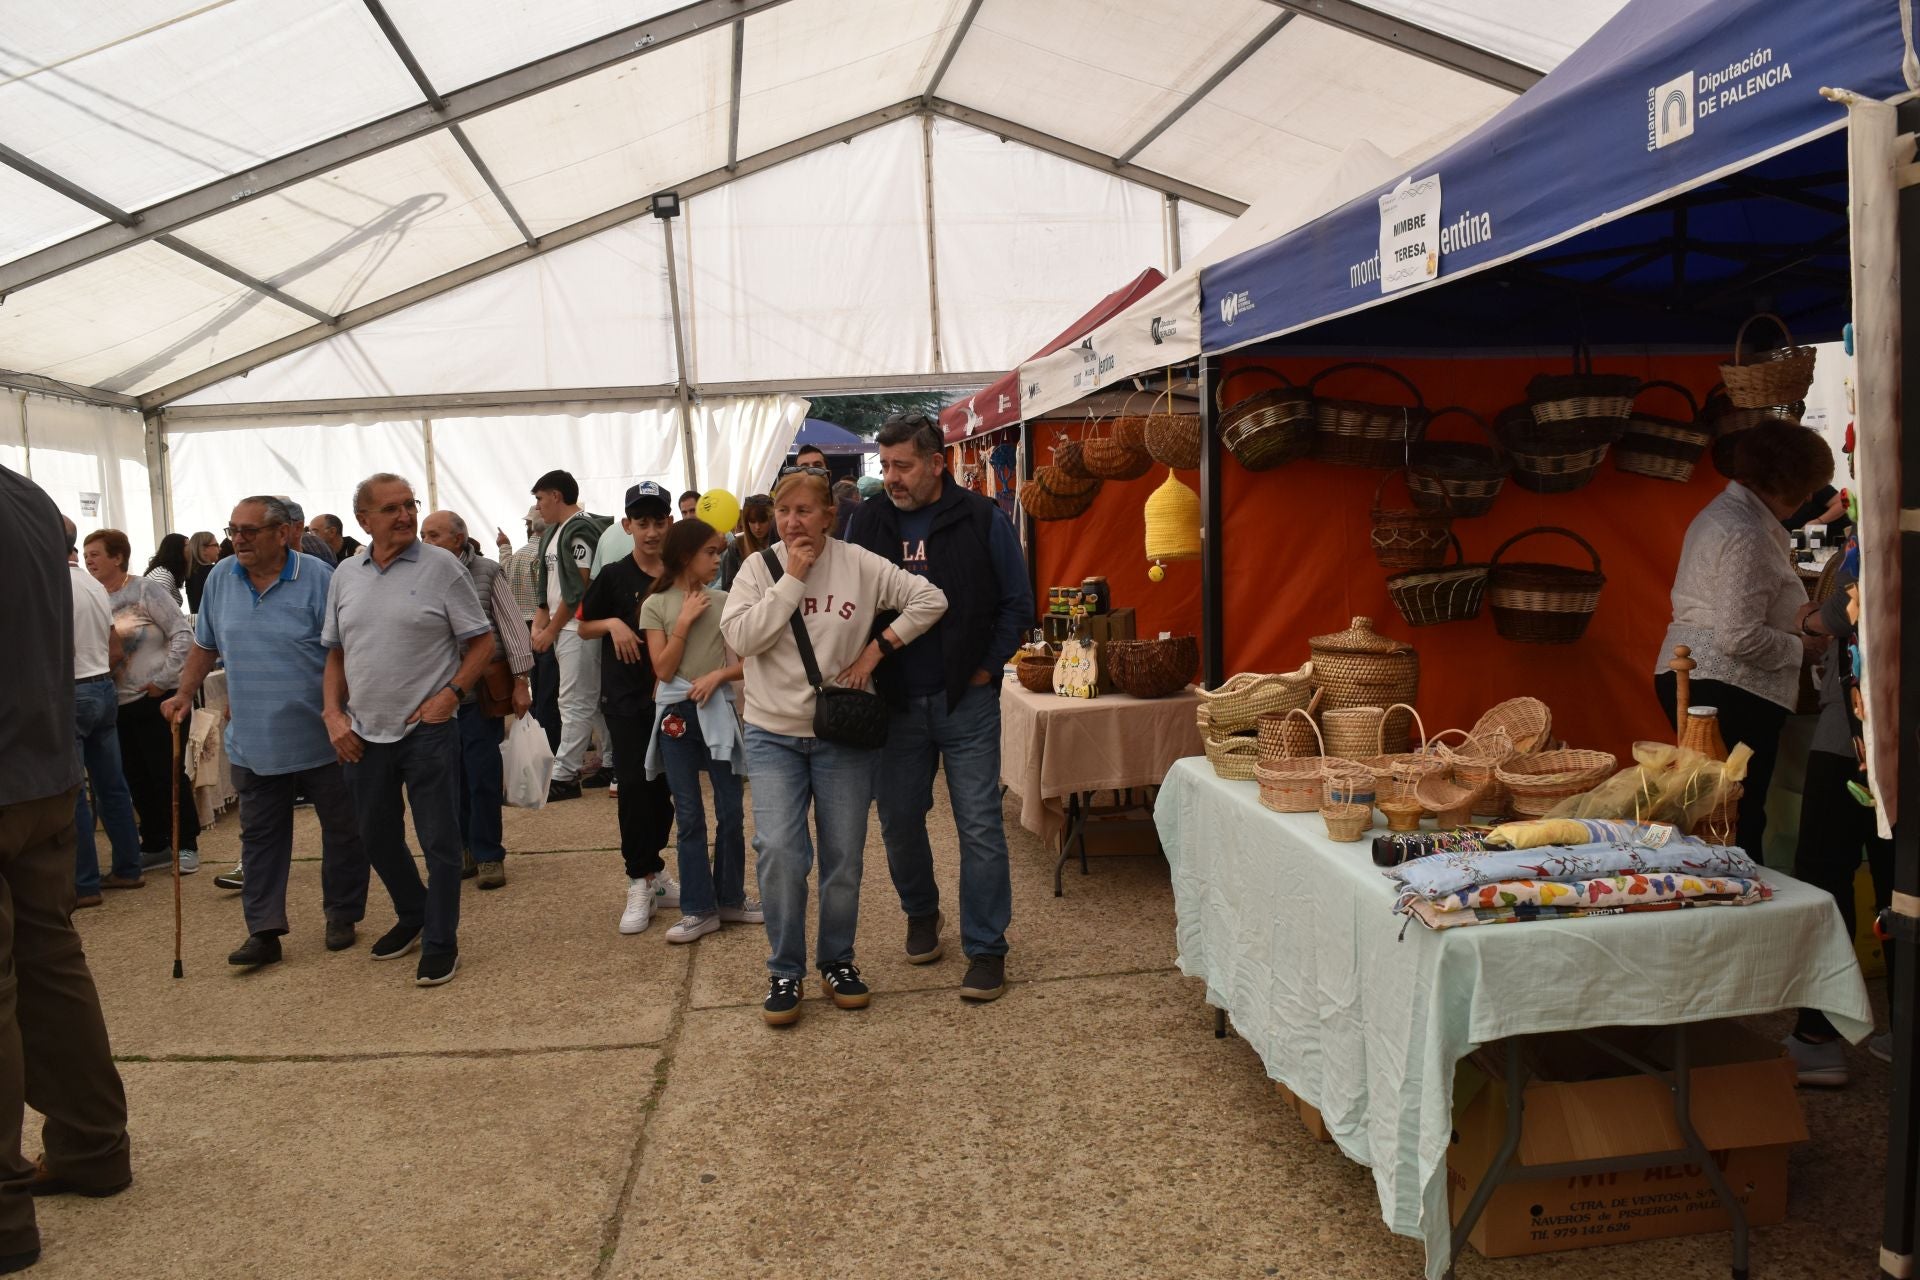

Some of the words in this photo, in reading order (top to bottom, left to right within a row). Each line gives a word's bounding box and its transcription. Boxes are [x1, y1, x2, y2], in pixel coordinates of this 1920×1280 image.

[1698, 48, 1772, 94] Diputación
[1699, 96, 1717, 118] DE
[1720, 62, 1792, 108] PALENCIA
[1647, 87, 1656, 152] financia
[1350, 250, 1382, 288] mont
[1438, 211, 1492, 255] entina
[1394, 241, 1427, 263] TERESA
[573, 546, 585, 560] hp
[803, 594, 857, 620] RIS
[1531, 1213, 1591, 1227] NAVEROS
[1598, 1211, 1611, 1221] de
[1618, 1205, 1680, 1219] PISUERGA
[1569, 1200, 1607, 1212] CTRA.
[1611, 1198, 1627, 1208] DE
[1553, 1227, 1578, 1239] 979
[1583, 1224, 1604, 1236] 142
[1606, 1222, 1631, 1233] 626
